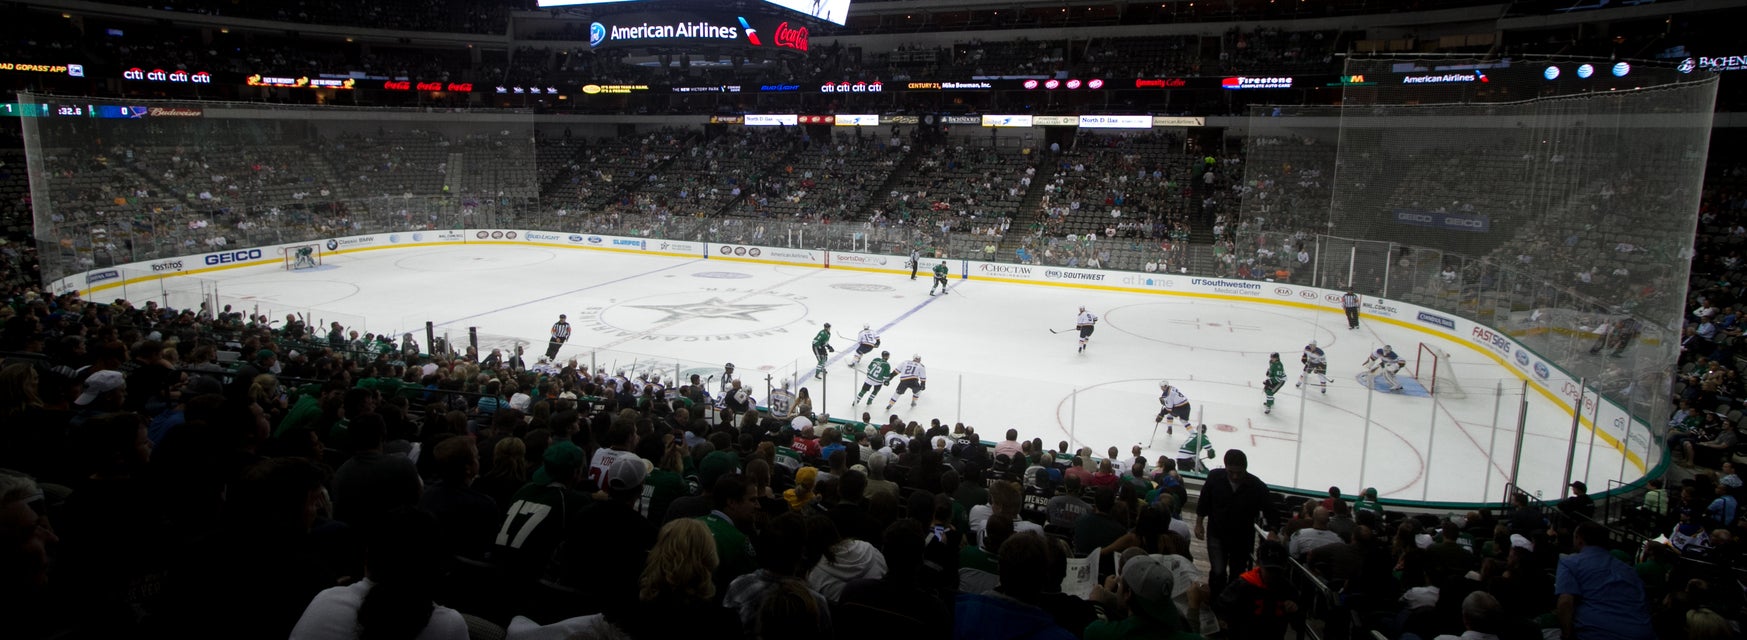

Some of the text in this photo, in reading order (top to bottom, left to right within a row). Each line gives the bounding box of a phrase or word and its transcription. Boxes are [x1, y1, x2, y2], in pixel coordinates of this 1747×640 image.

[611, 22, 738, 41] American Airlines
[15, 63, 48, 72] GOPASS
[50, 65, 67, 73] APP
[124, 68, 144, 80] citi
[148, 69, 166, 81] citi
[169, 70, 188, 82] citi
[191, 71, 211, 83] citi
[1403, 74, 1475, 83] American Airlines
[821, 82, 835, 92] citi
[837, 82, 850, 92] citi
[852, 82, 866, 92] citi
[868, 82, 882, 92] citi
[956, 82, 981, 90] Bowman,
[6, 104, 12, 113] 1
[58, 107, 82, 116] :32.6
[121, 107, 128, 116] 0
[150, 106, 202, 117] Budweiser
[204, 248, 262, 266] GEICO
[986, 263, 1033, 274] CHOCTAW
[1063, 271, 1105, 281] SOUTHWEST
[1122, 275, 1135, 285] at
[1202, 279, 1261, 290] Southwestern
[640, 327, 789, 343] AMERICAN
[864, 333, 873, 342] 15
[870, 363, 882, 378] 72
[905, 365, 916, 375] 21
[495, 499, 553, 550] 17
